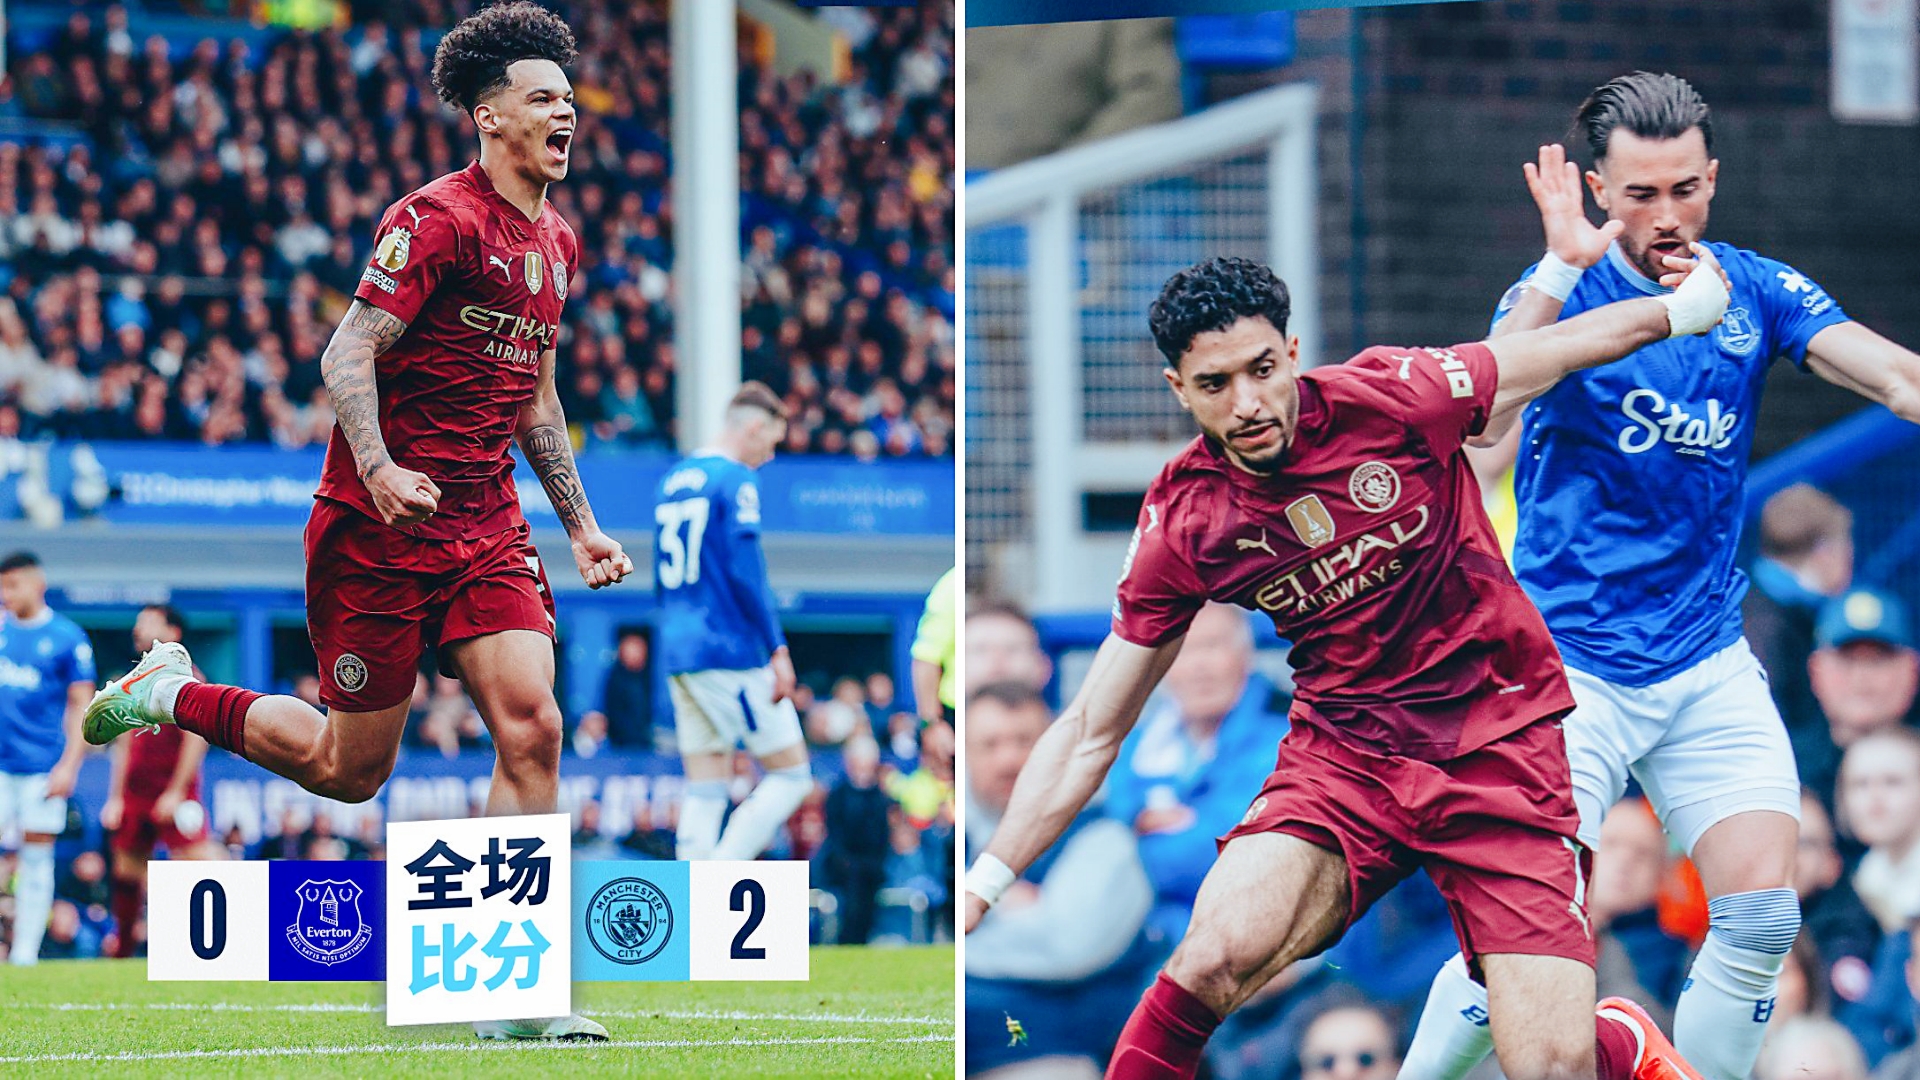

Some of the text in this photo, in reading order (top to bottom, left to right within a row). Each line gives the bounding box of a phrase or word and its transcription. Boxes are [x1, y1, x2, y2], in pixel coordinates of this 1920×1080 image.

[483, 340, 539, 365] AIRWAYS
[655, 496, 710, 590] 37
[1255, 505, 1429, 611] ETIHAD
[1297, 558, 1403, 614] AIRWAYS
